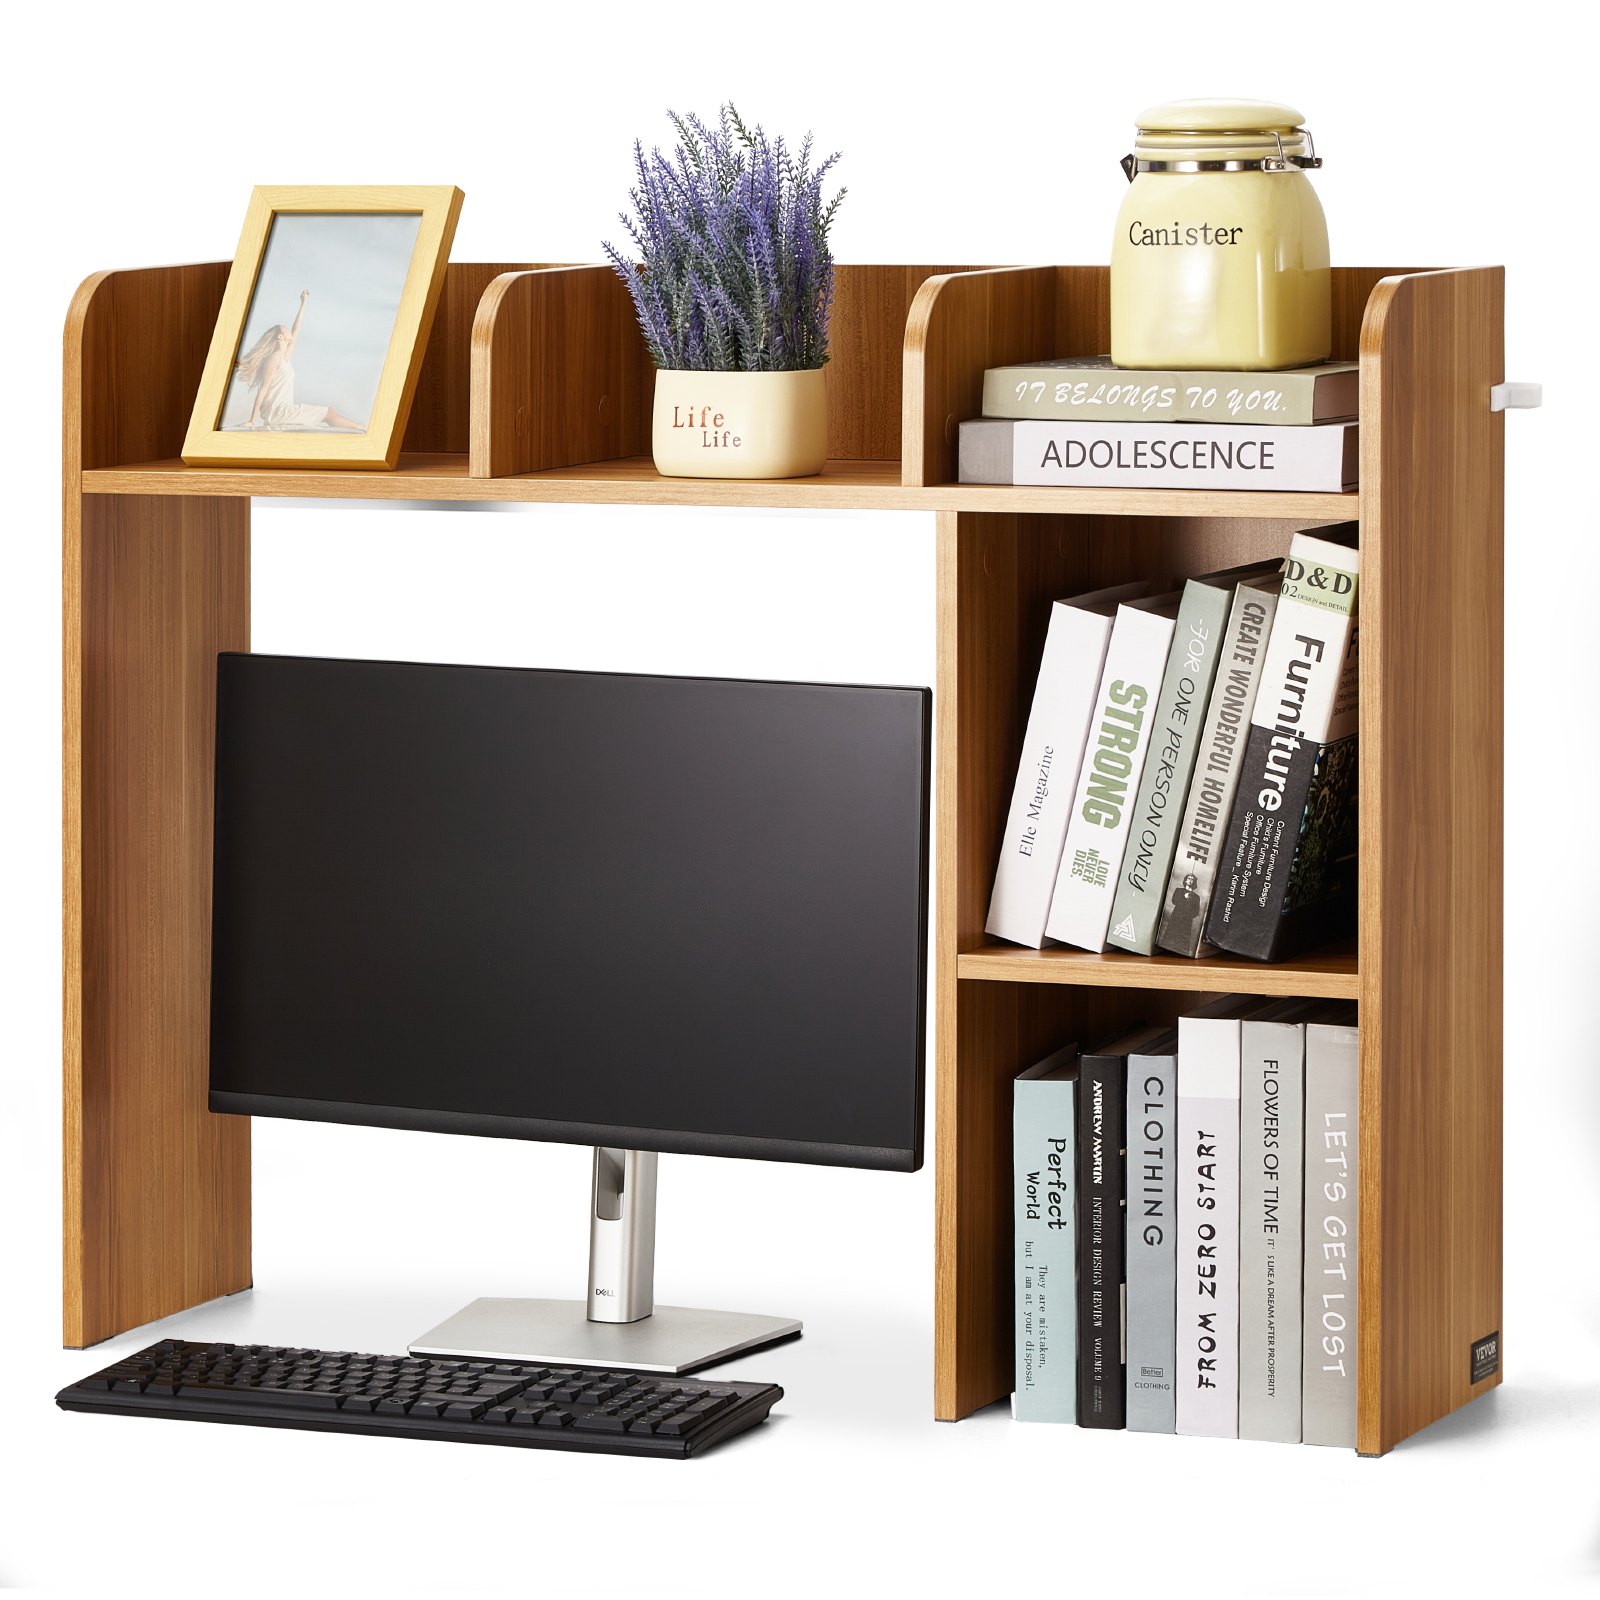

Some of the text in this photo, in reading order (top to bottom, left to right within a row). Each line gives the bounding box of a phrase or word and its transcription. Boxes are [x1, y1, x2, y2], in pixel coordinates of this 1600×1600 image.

[1129, 221, 1243, 246] Canister
[1015, 381, 1287, 416] IT BELONGS TO YOU.
[672, 406, 725, 428] Life
[702, 431, 742, 447] Life
[1040, 440, 1275, 470] ADOLESCENCE
[1281, 582, 1298, 598] 02
[1298, 594, 1318, 605] DESIGN
[1328, 602, 1349, 612] DETAIL
[1172, 677, 1195, 726] ONE
[1186, 602, 1267, 865] CREATE WONDERFUL HOMELIFE
[1258, 634, 1326, 812] Furniture
[1082, 679, 1148, 829] STRONG
[1146, 727, 1182, 827] PERSON
[1019, 745, 1054, 857] Elle Magazine
[1242, 811, 1254, 839] Special
[1070, 849, 1087, 878] DIES.
[1235, 839, 1248, 867] Feature
[1240, 814, 1264, 897] Office Furniture System
[1255, 818, 1275, 875] Child's Furniture
[1258, 820, 1285, 907] Current Furniture Design
[1082, 848, 1100, 884] NEVER
[1094, 860, 1110, 888] LOVE
[1263, 1059, 1279, 1149] FLOWERS
[1093, 1080, 1103, 1185] ANDREW MARTIN
[1143, 1076, 1164, 1246] CLOTHING
[1263, 1153, 1279, 1181] OF
[1026, 1171, 1041, 1220] World
[1047, 1138, 1067, 1230] Perfect
[1093, 1197, 1102, 1244] INTERIOR
[1263, 1186, 1279, 1233] TIME
[1025, 1241, 1034, 1258] but
[1196, 1130, 1217, 1389] FROM ZERO START
[1322, 1112, 1347, 1377] LET'S GET LOST
[1025, 1276, 1031, 1289] am
[1038, 1265, 1048, 1289] They
[1093, 1249, 1102, 1285] DESIGN
[1267, 1260, 1275, 1278] LIKE
[1025, 1294, 1033, 1305] at
[1093, 1291, 1102, 1328] REVIEW
[1267, 1287, 1275, 1319] DREAM
[1024, 1312, 1032, 1336] your
[1267, 1319, 1275, 1346] AFTER
[1038, 1318, 1049, 1369] mistaken,
[1094, 1337, 1102, 1372] VOLUME
[1024, 1340, 1035, 1391] disposal.
[1141, 1367, 1162, 1377] Better
[1267, 1348, 1275, 1398] PROSPERITY
[1134, 1381, 1170, 1391] CLOTHING
